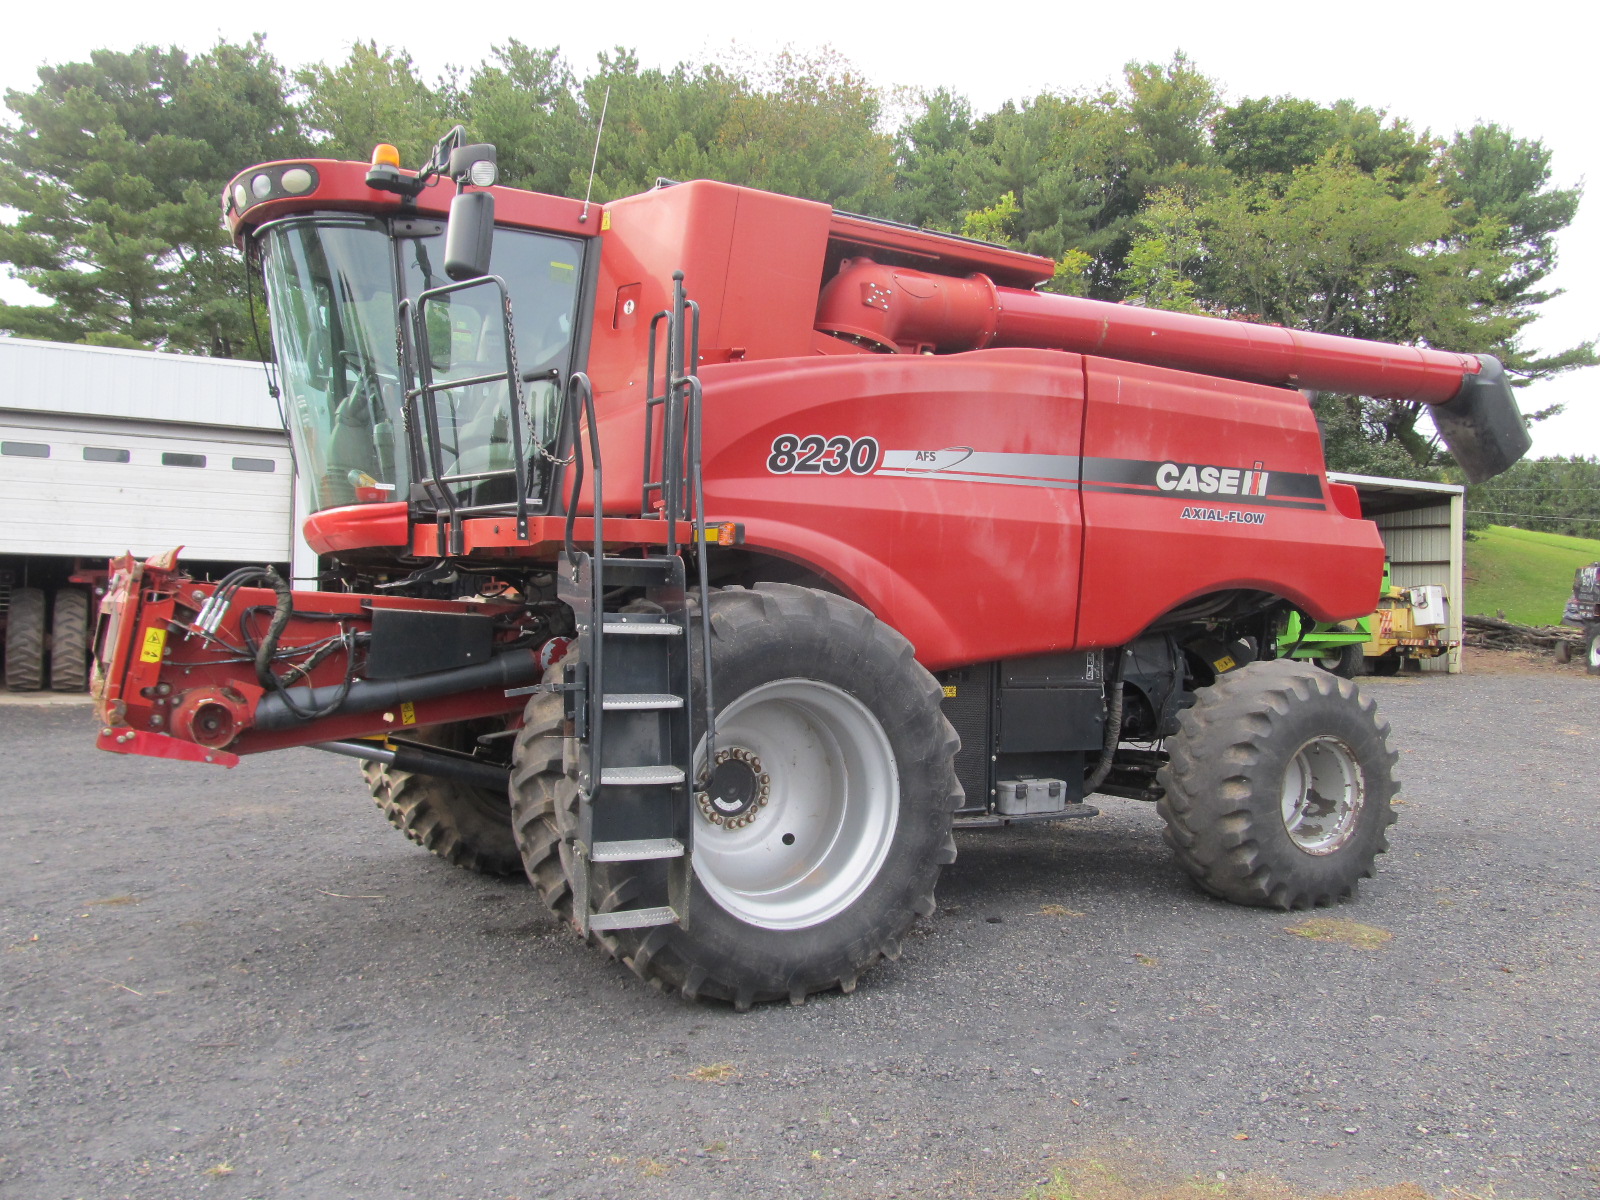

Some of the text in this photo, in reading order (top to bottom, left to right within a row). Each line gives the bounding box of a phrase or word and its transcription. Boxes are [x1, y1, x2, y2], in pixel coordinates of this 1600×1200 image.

[767, 434, 879, 475] 8230
[915, 450, 937, 462] AFS
[1180, 507, 1266, 525] AXIAL-FLOW
